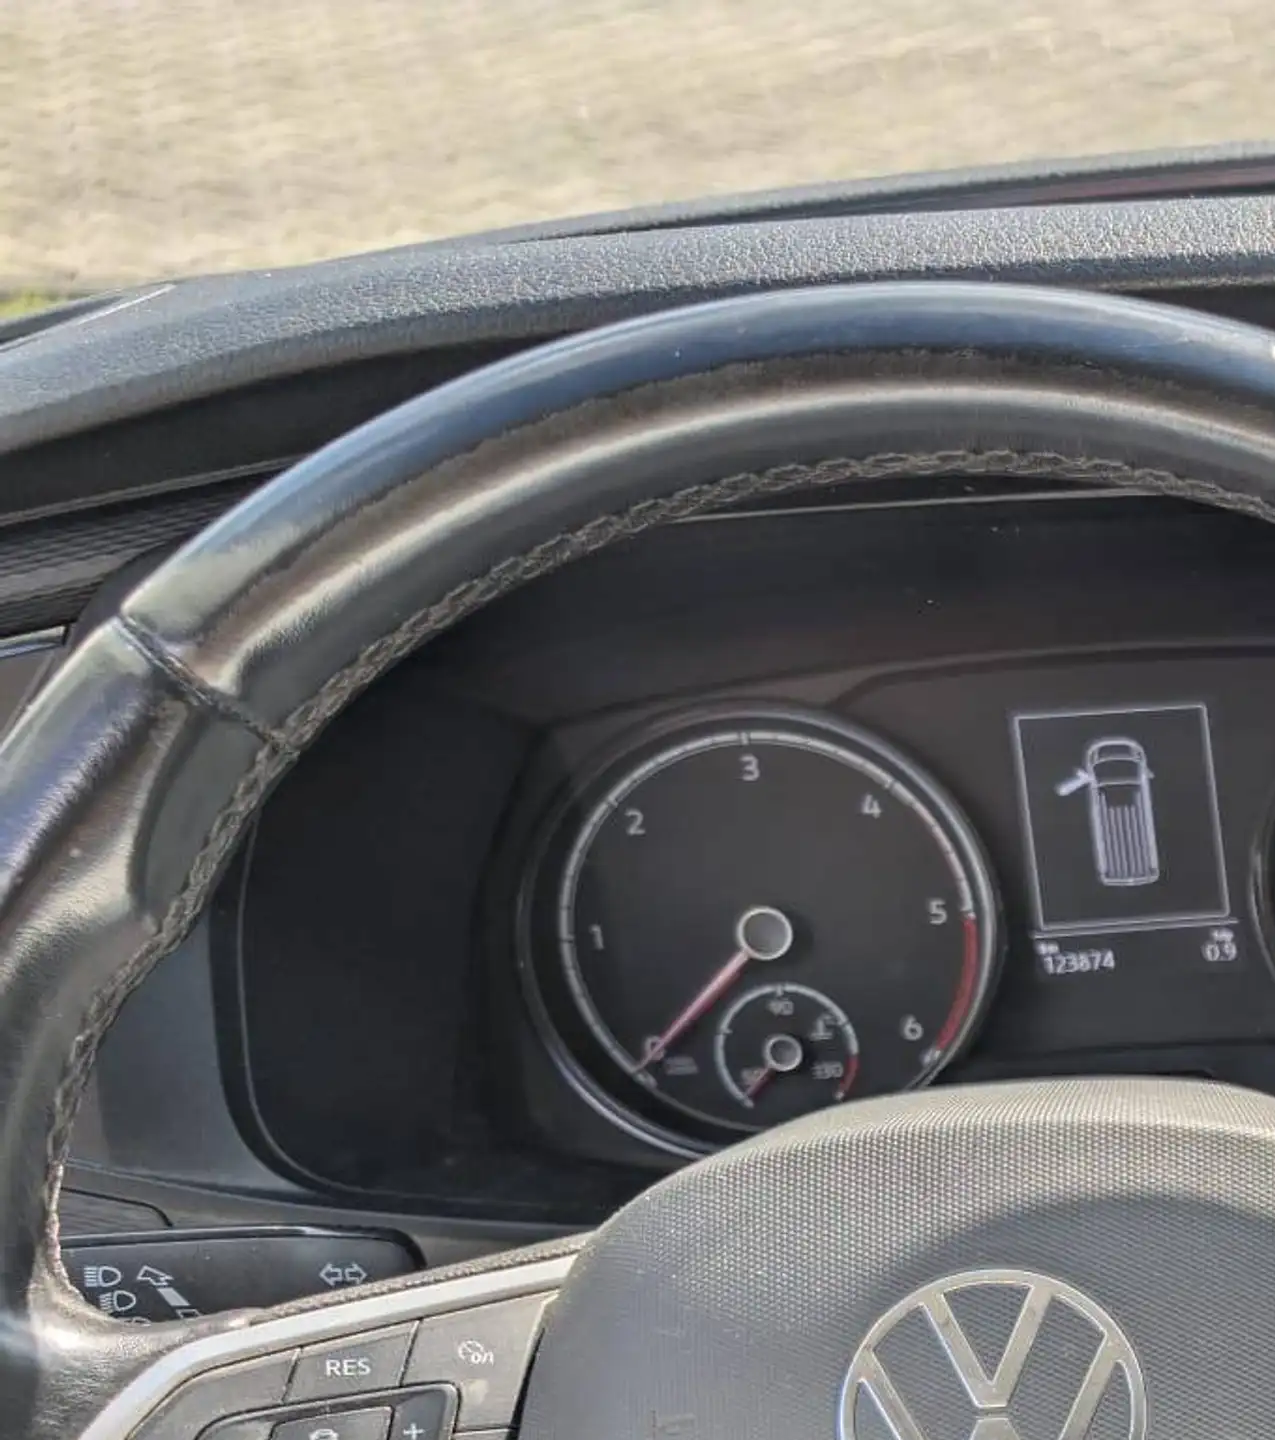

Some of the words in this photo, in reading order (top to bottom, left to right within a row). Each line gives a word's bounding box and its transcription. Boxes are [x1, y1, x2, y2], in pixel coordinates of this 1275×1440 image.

[739, 756, 760, 781] 3
[861, 795, 881, 818] 4
[625, 811, 646, 836] 2
[928, 900, 948, 925] 5
[591, 925, 604, 949] 1
[903, 1017, 923, 1040] 6
[325, 1358, 371, 1376] RES
